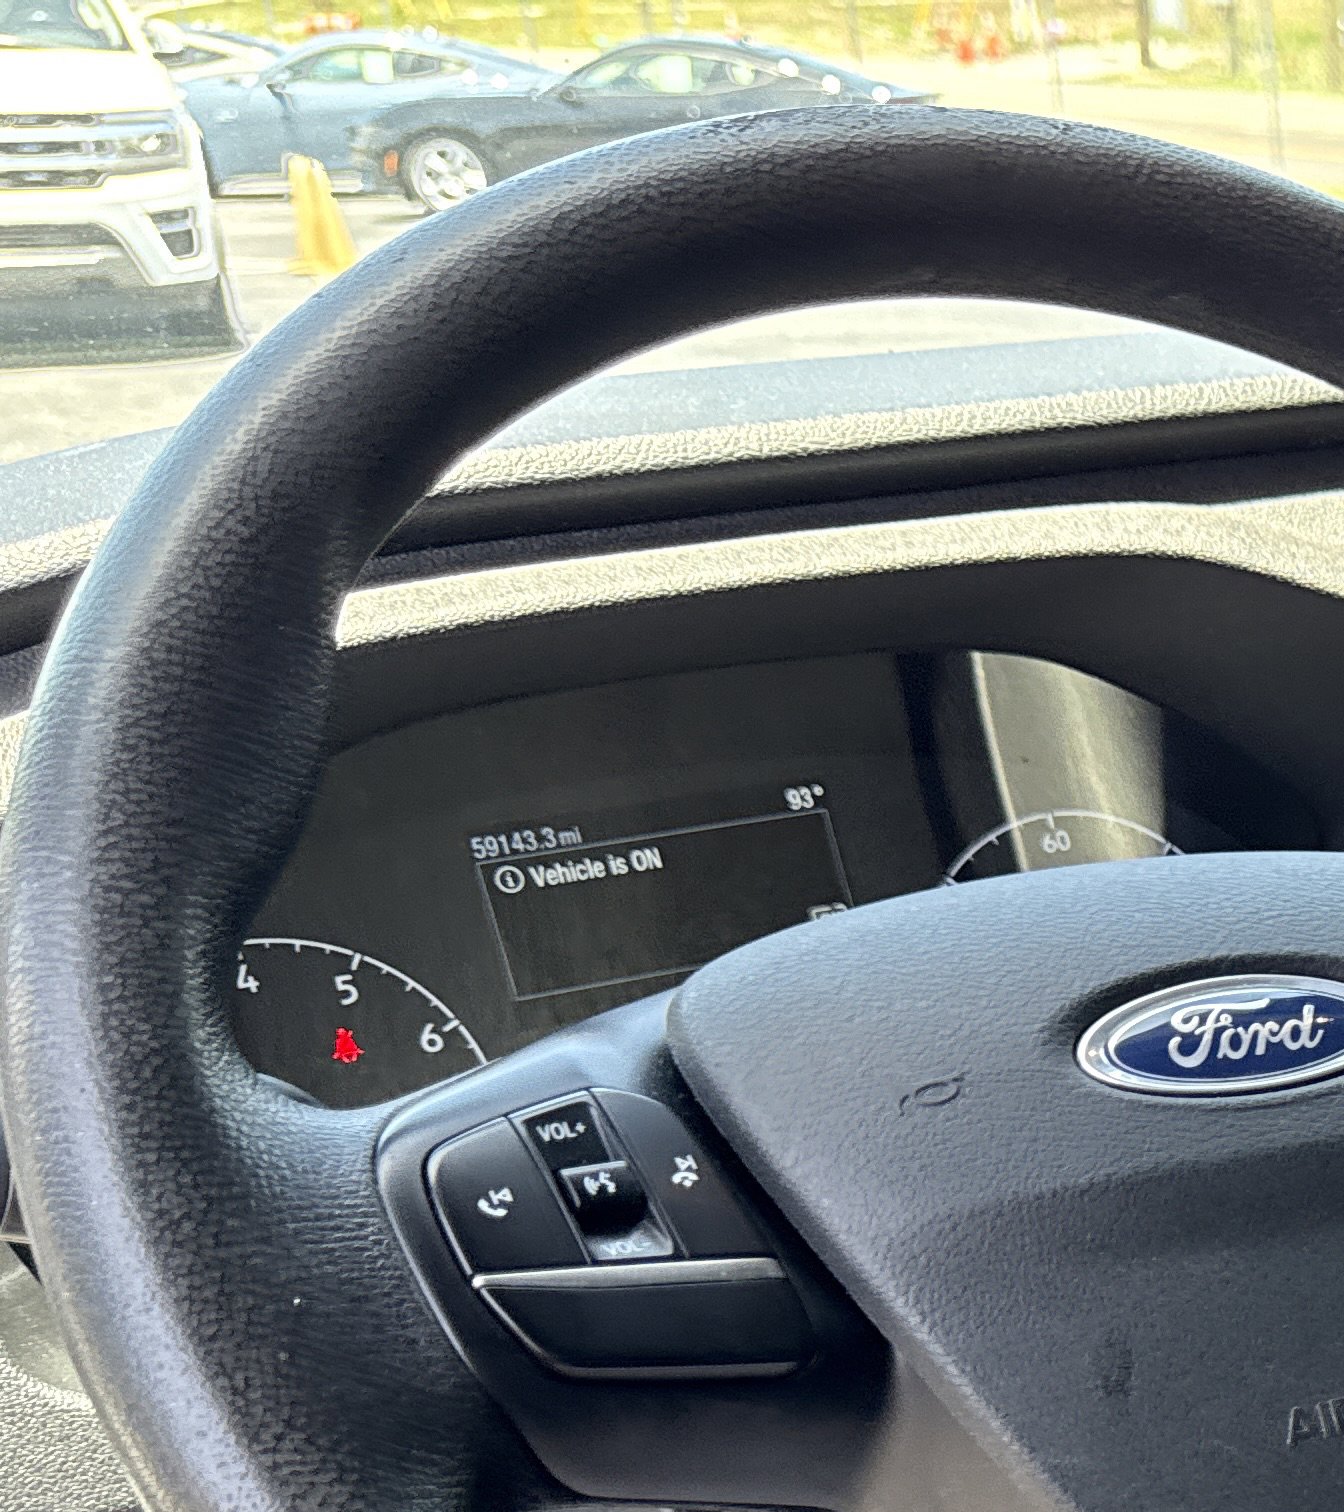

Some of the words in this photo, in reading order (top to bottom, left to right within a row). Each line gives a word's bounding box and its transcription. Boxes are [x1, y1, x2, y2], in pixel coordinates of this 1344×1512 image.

[782, 783, 825, 812] 93°
[469, 827, 558, 861] 59143.3
[1039, 828, 1072, 855] 60
[528, 855, 606, 889] Vehicle
[607, 852, 629, 876] is
[630, 845, 665, 872] ON
[236, 963, 261, 994] 4
[333, 973, 360, 1006] 5
[419, 1022, 446, 1054] 6
[1165, 996, 1325, 1069] Ford
